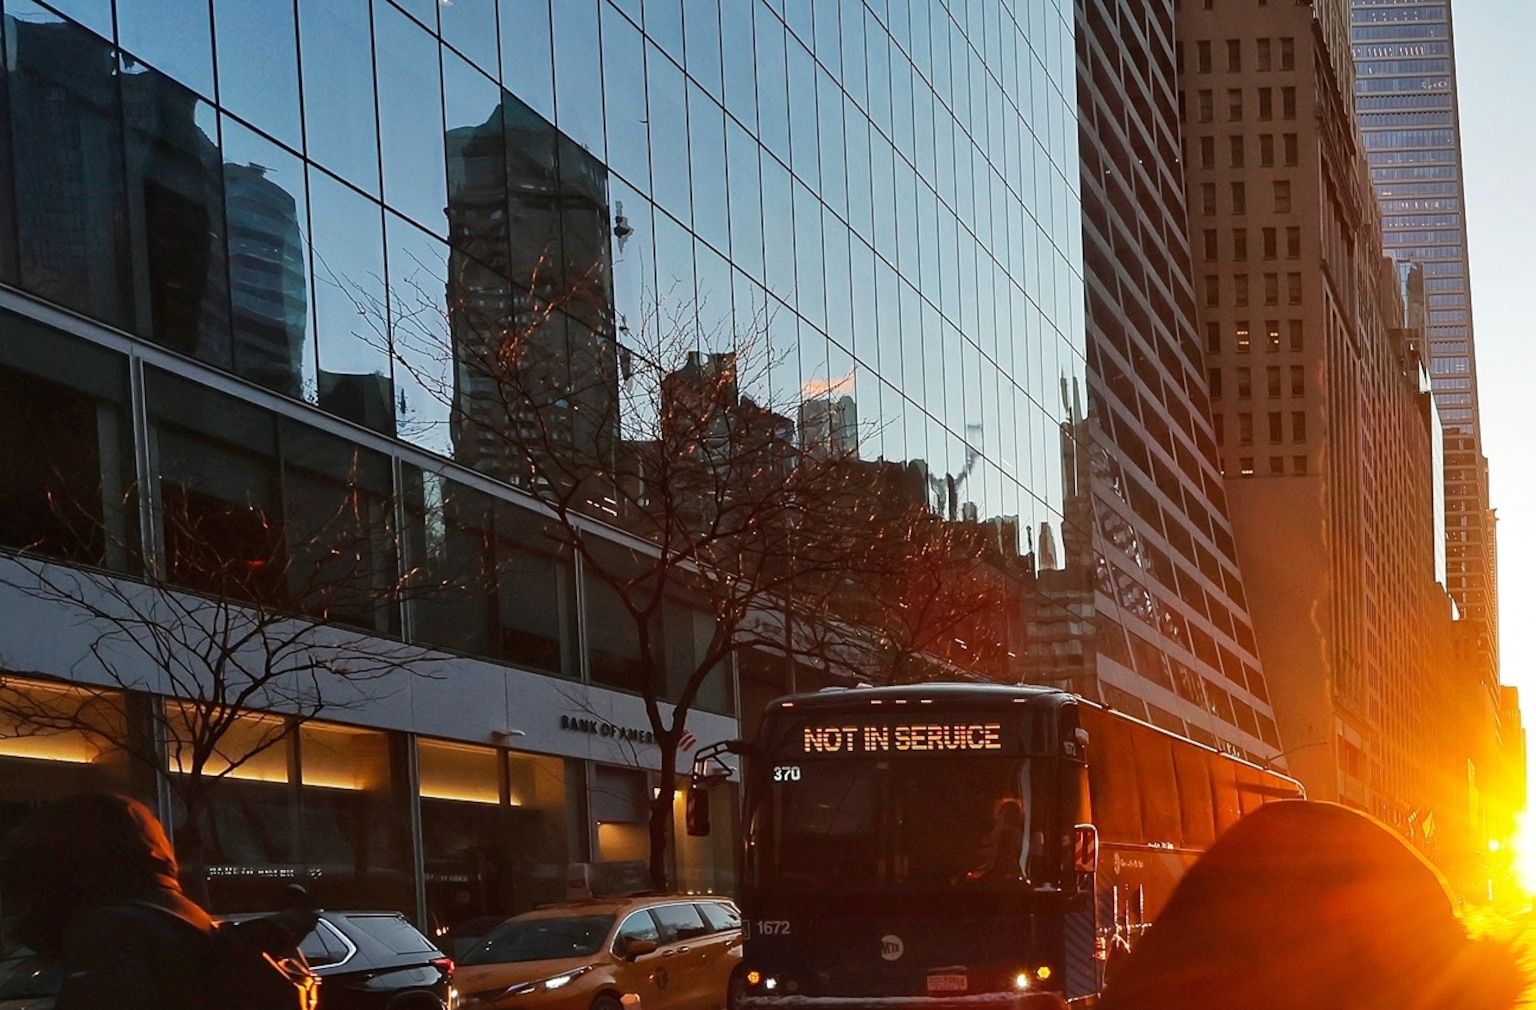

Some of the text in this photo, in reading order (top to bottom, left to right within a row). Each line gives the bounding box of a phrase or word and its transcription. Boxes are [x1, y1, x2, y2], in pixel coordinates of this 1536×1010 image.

[560, 715, 597, 735] BANK
[599, 723, 617, 738] OF
[804, 726, 858, 752] NOT
[864, 725, 889, 751] IN
[773, 766, 801, 781] 370
[757, 920, 791, 935] 1672
